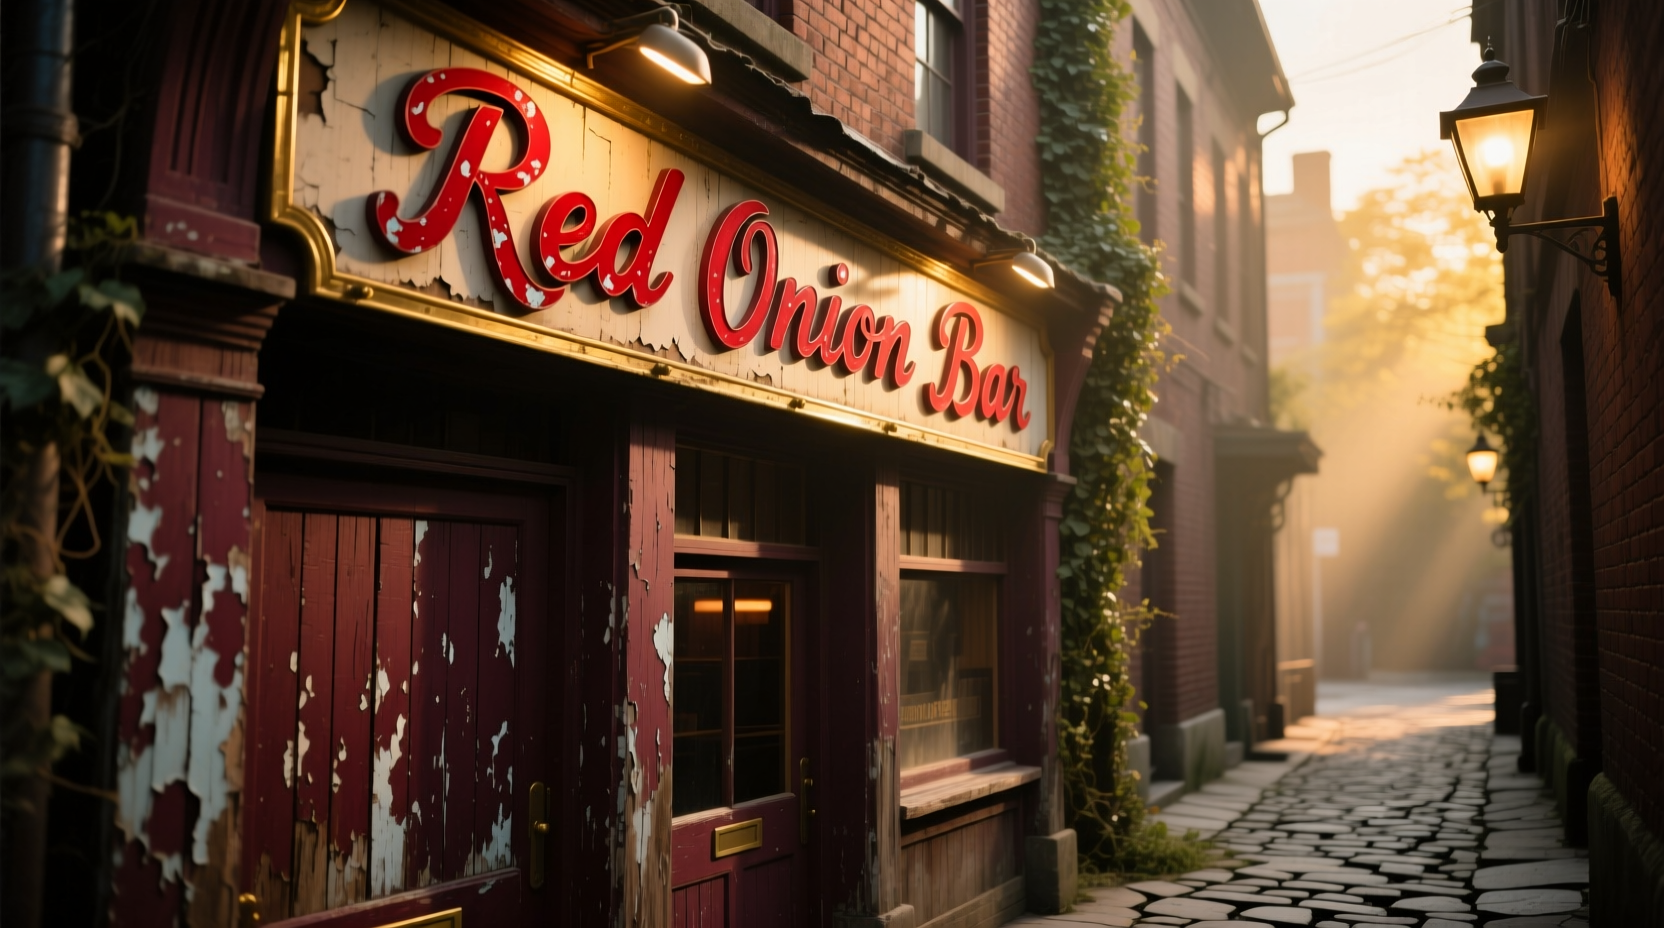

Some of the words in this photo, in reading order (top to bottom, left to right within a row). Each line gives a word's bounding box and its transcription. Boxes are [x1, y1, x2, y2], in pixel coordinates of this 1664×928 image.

[367, 66, 685, 311] Red
[698, 200, 915, 388] Onion
[924, 301, 1031, 431] Bar
